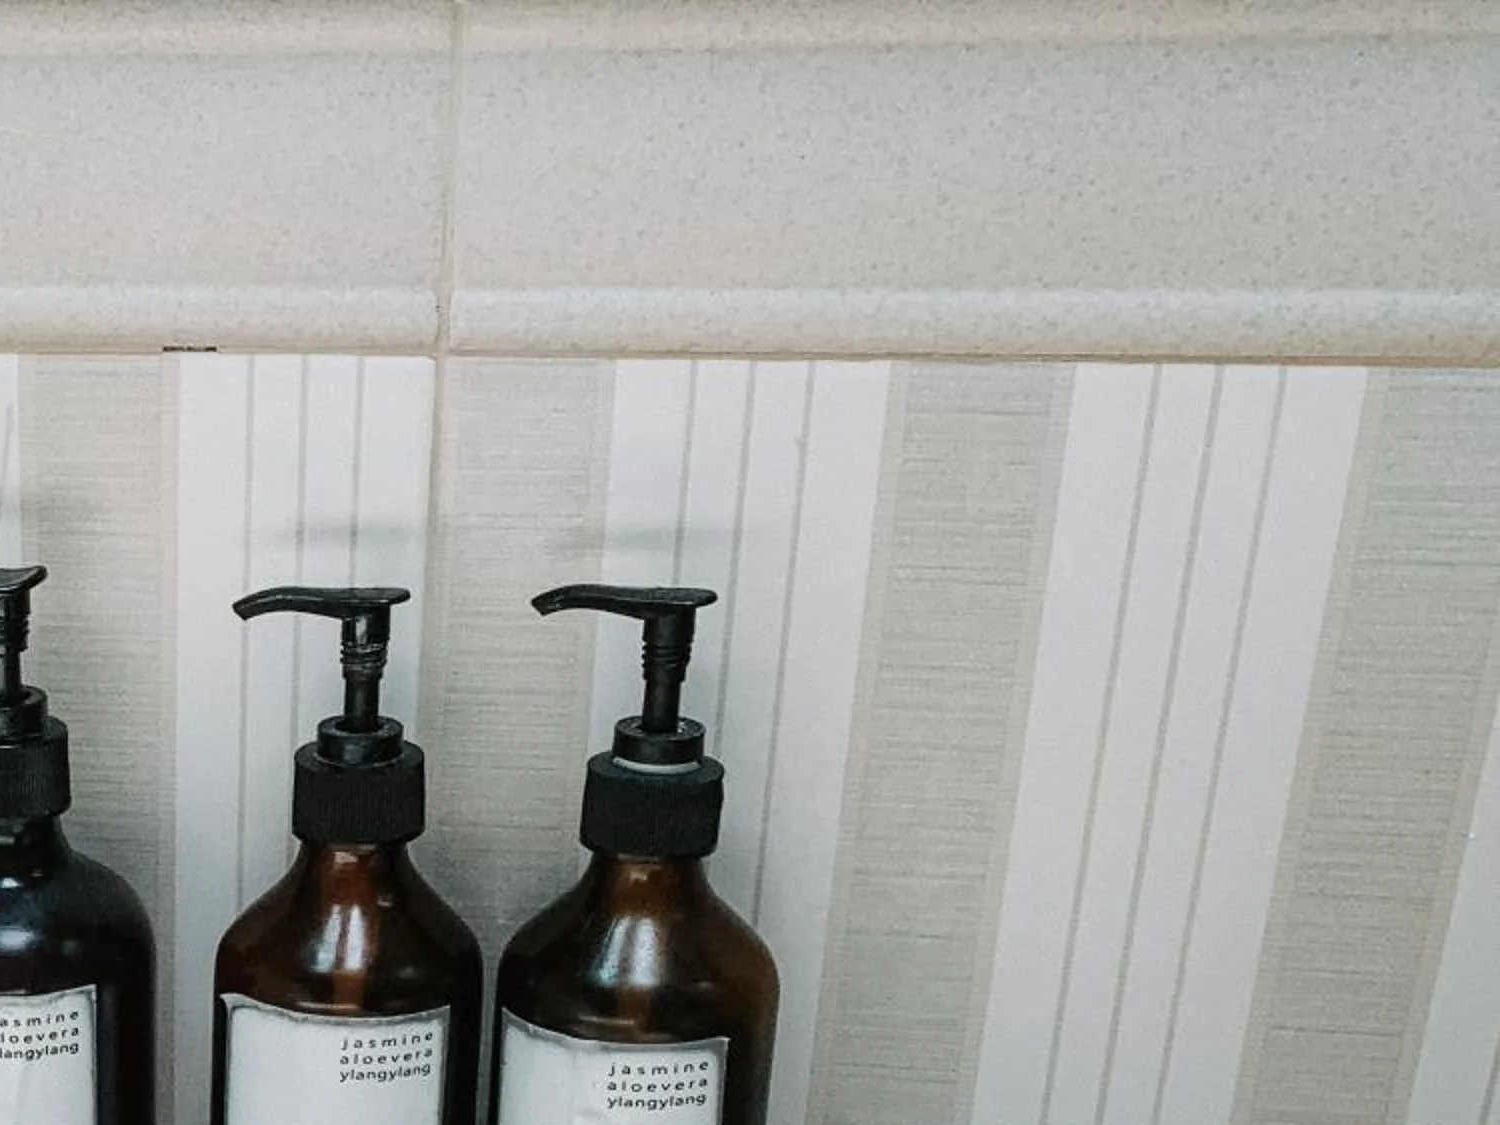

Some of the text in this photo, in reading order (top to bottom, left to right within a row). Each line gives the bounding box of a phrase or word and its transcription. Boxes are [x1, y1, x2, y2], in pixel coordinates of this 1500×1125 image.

[341, 1032, 433, 1051] jasmine
[340, 1048, 433, 1065] aloevera
[340, 1063, 431, 1083] ylangylang
[608, 1061, 709, 1077] jasmine
[607, 1078, 708, 1093] aloevera
[607, 1094, 707, 1111] ylangylang
